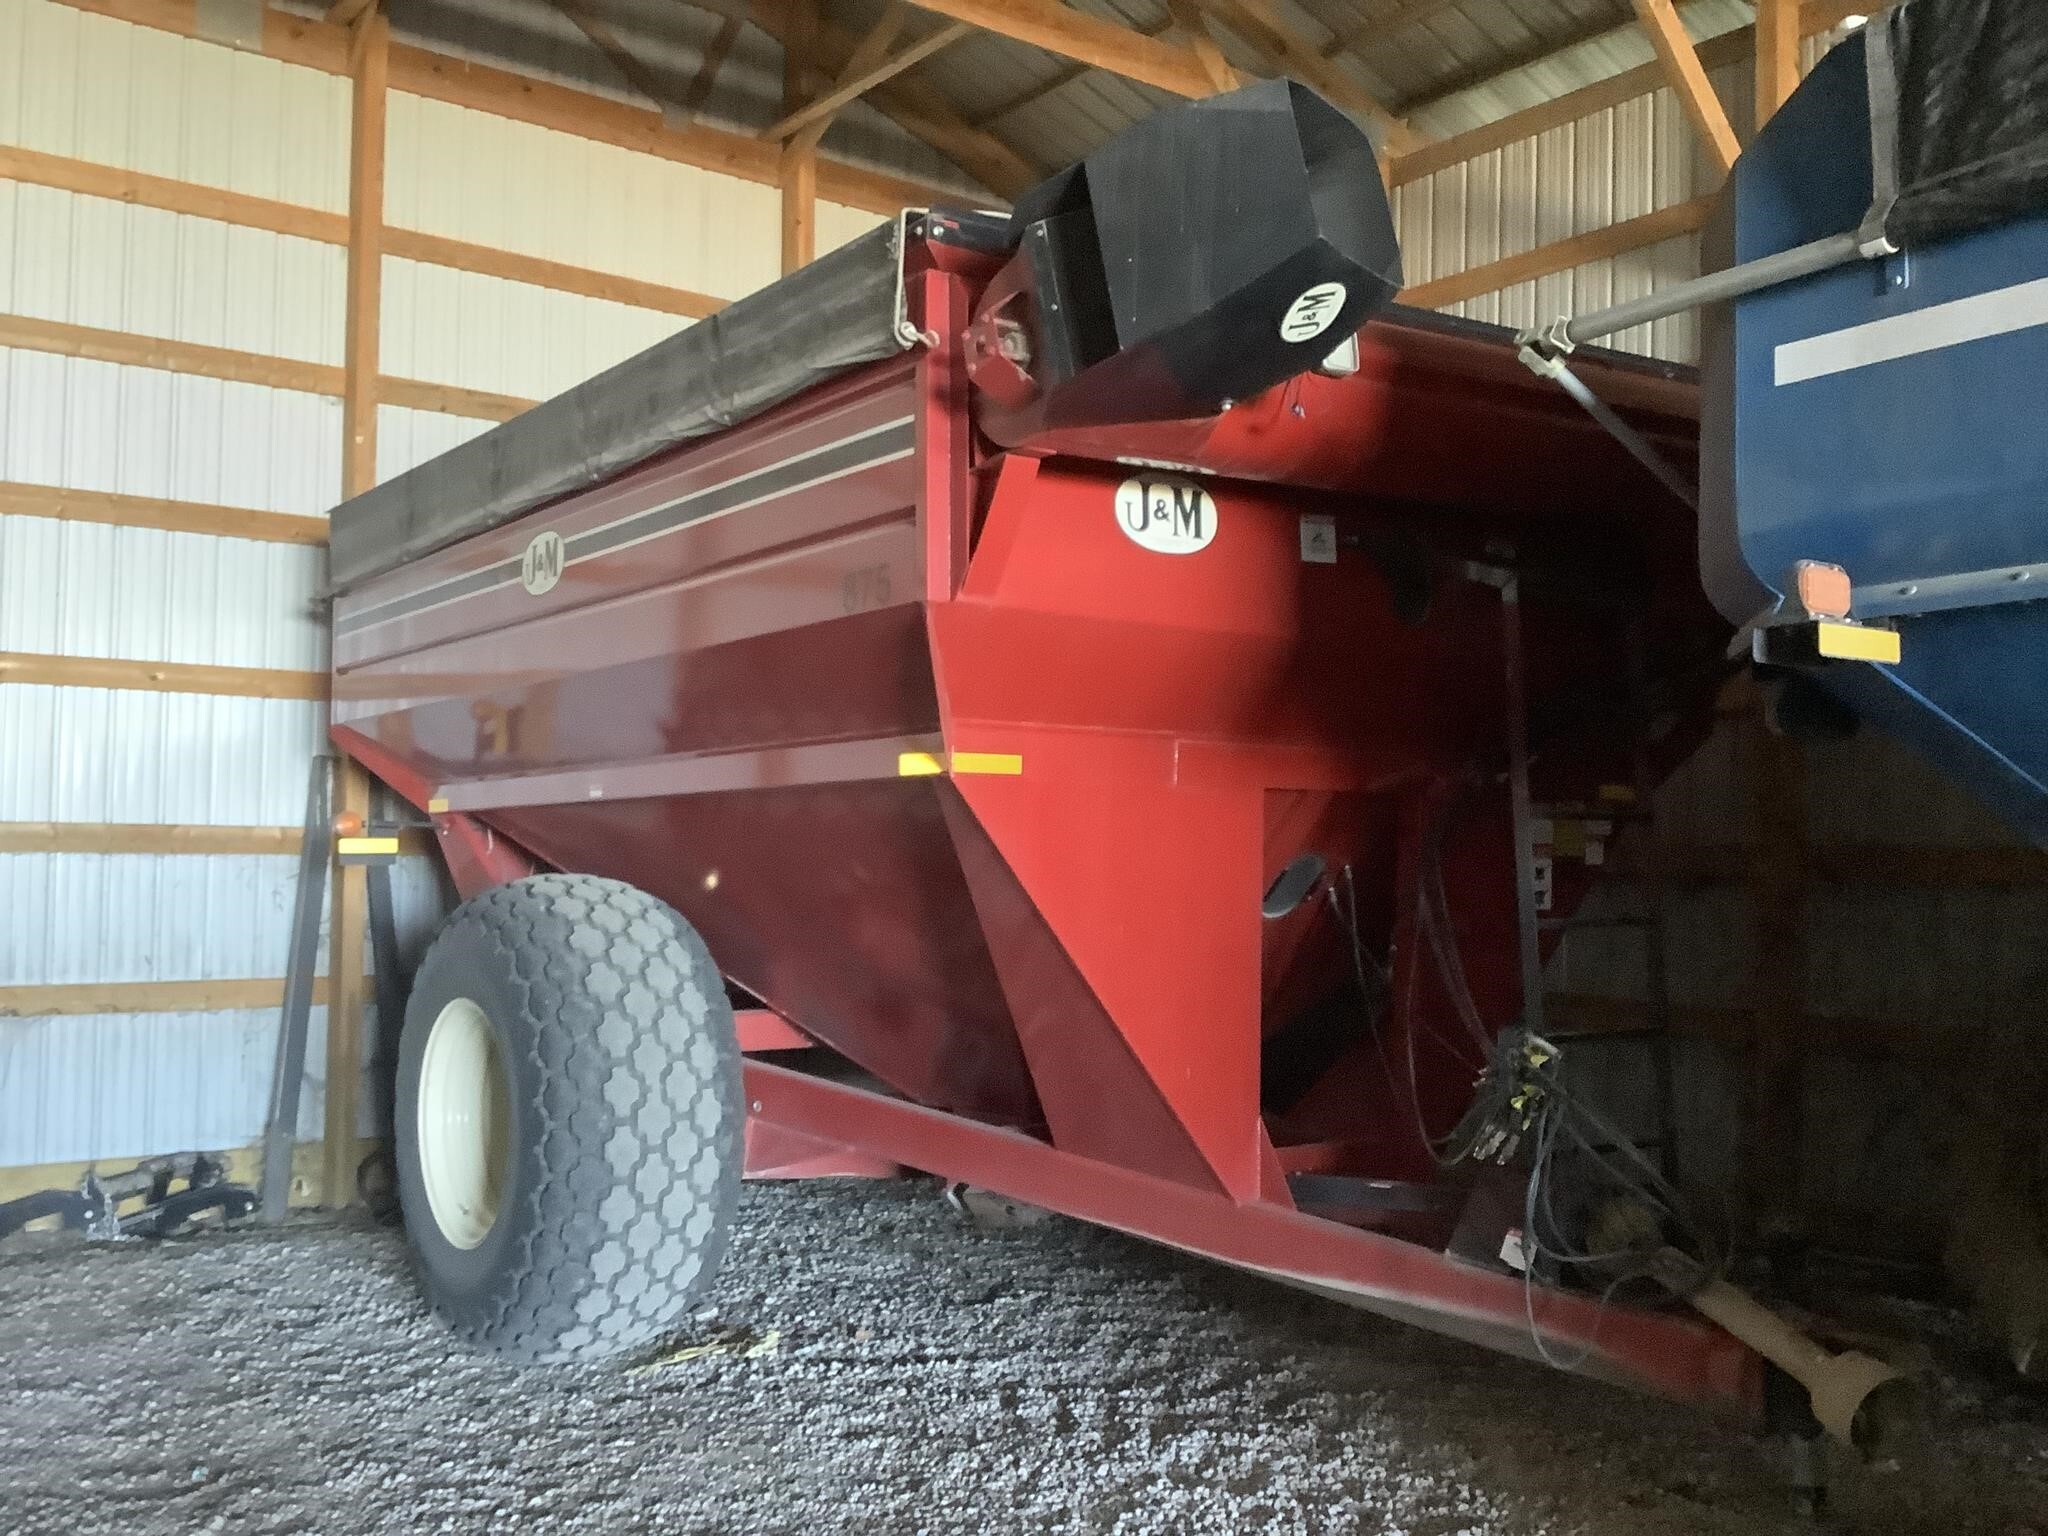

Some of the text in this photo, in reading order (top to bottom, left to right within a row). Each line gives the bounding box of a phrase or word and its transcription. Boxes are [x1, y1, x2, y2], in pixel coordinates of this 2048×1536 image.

[1288, 291, 1337, 336] J&M
[1126, 484, 1203, 539] J&M
[526, 537, 559, 585] J&M
